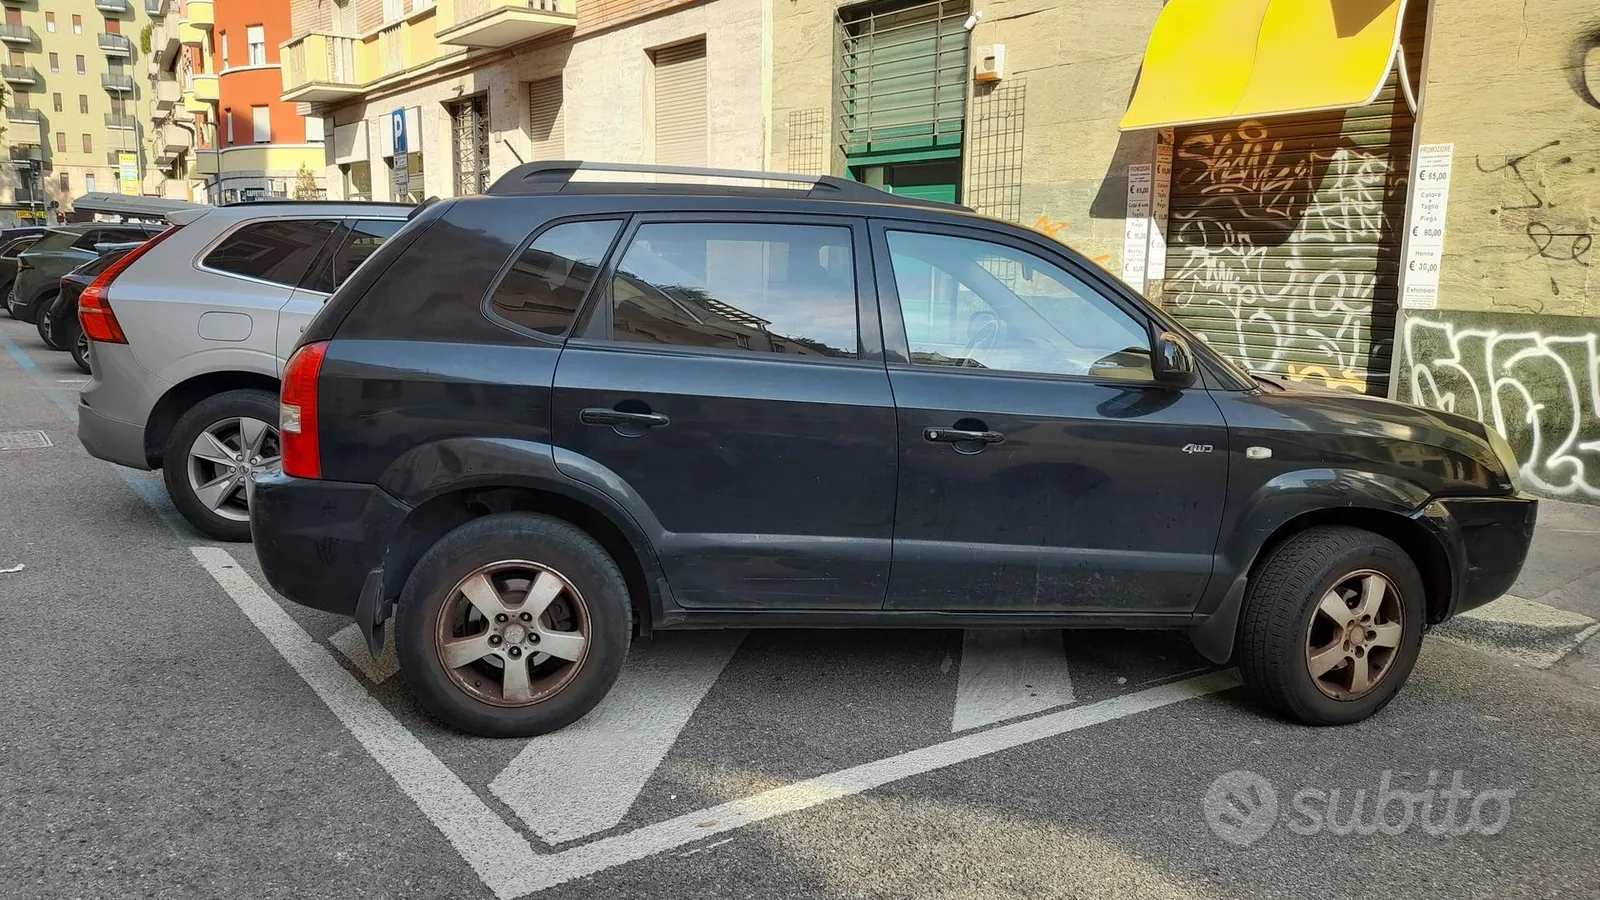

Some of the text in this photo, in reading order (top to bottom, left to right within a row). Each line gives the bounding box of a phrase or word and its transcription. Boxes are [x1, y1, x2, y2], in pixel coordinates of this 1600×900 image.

[394, 113, 403, 149] P
[1419, 170, 1426, 180] €
[1130, 185, 1135, 194] €
[1412, 226, 1419, 237] €
[1409, 260, 1415, 271] €
[1181, 443, 1214, 454] 4WD
